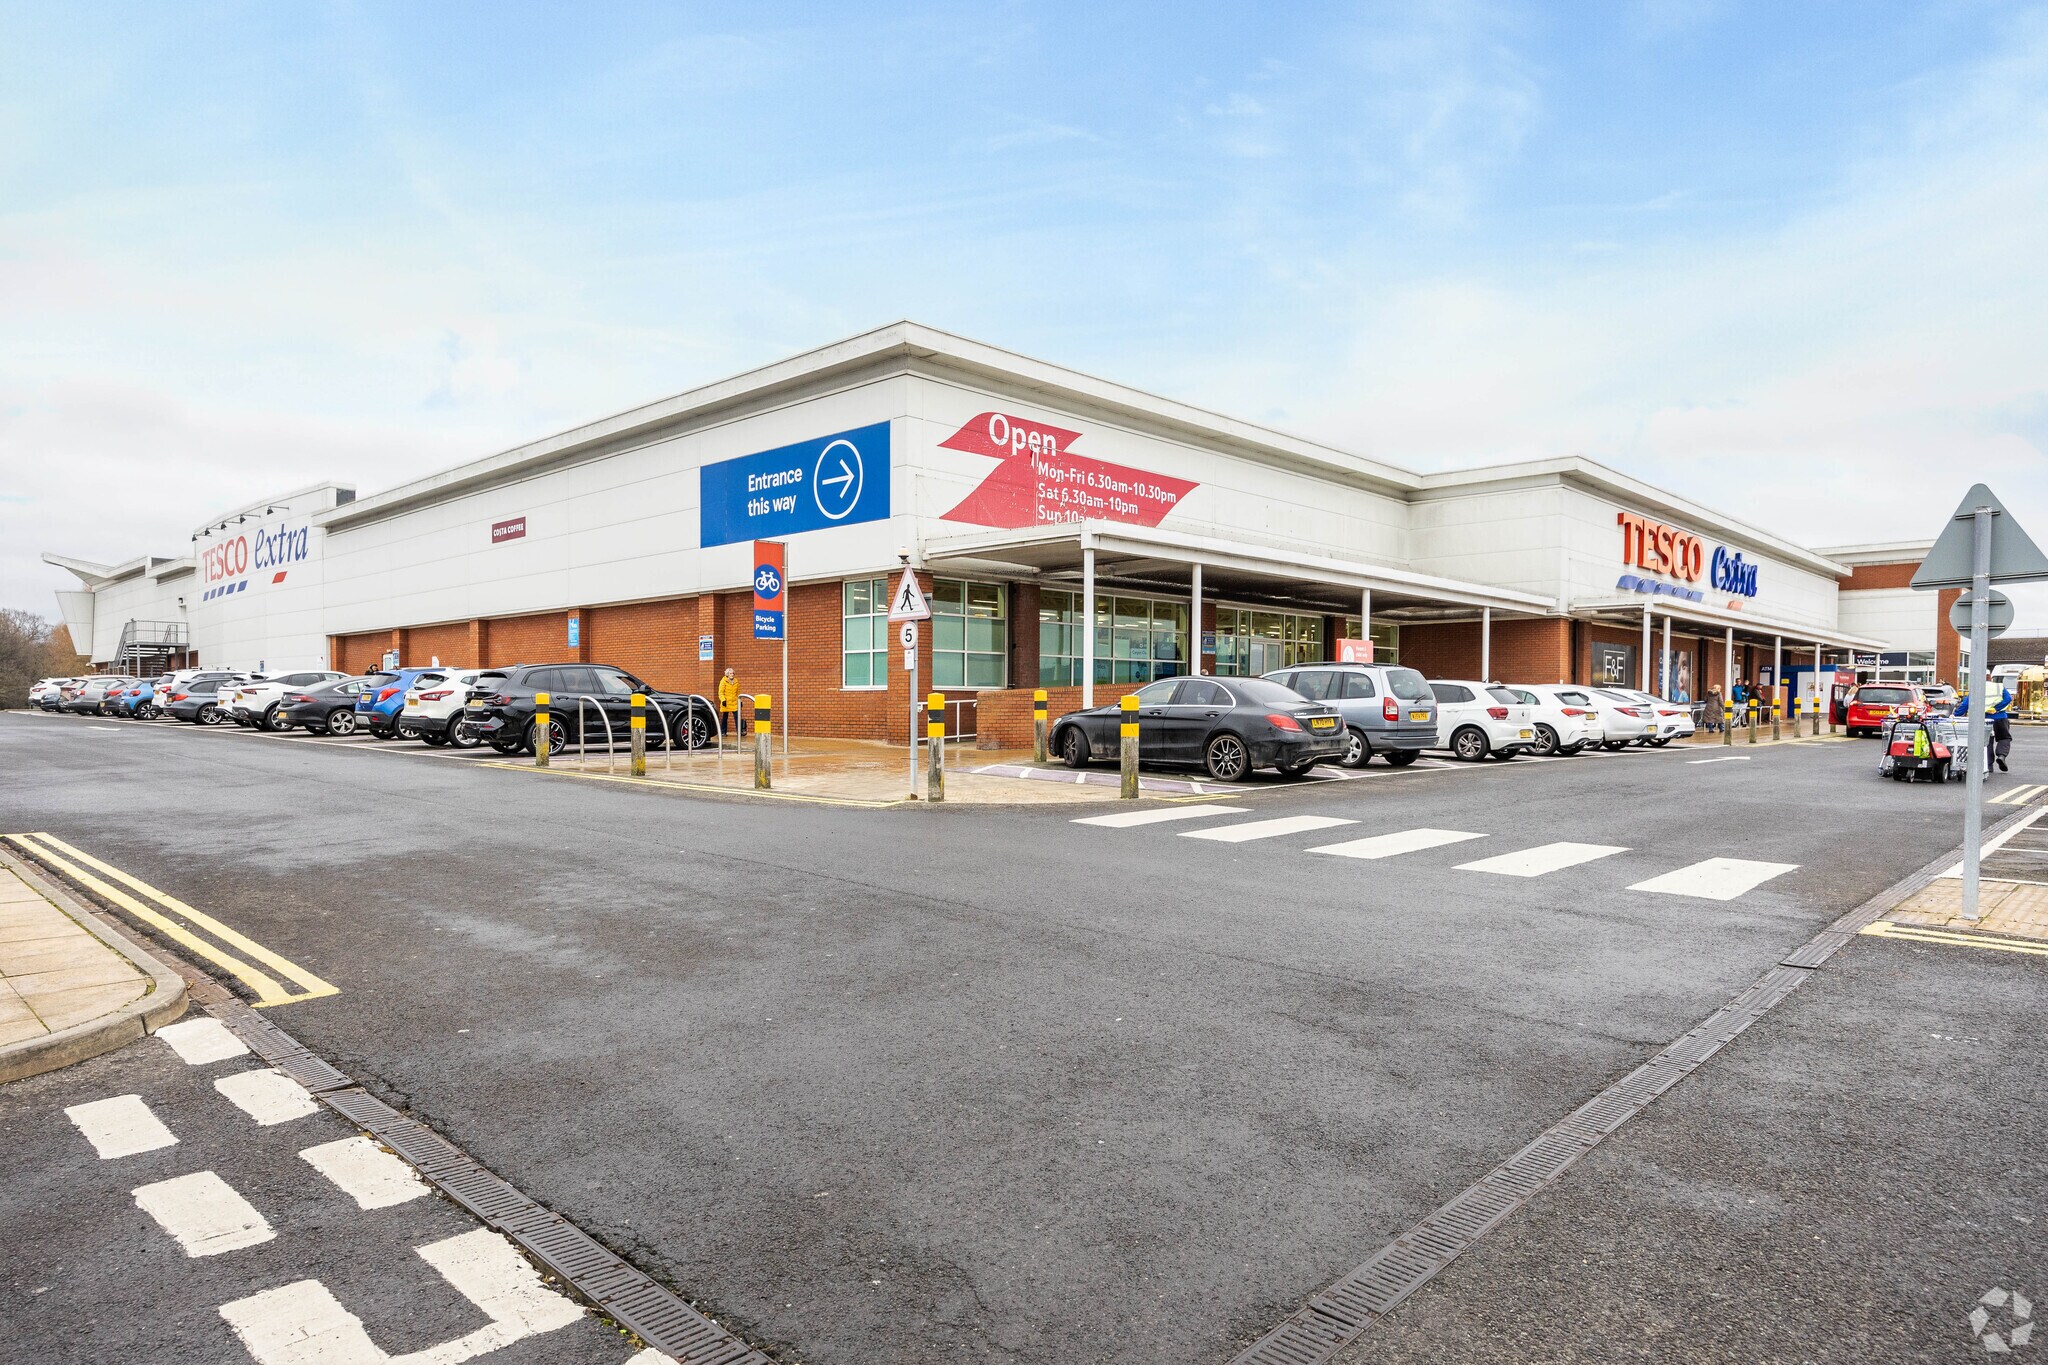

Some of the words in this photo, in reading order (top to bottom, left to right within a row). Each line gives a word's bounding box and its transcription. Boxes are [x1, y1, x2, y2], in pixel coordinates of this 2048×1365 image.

[989, 413, 1057, 456] Open
[748, 468, 803, 492] Entrance
[1038, 461, 1085, 484] Mon-Fri
[1088, 472, 1177, 504] 6.30am-10.30pm
[748, 497, 770, 517] this
[772, 495, 797, 514] way
[1038, 483, 1059, 500] Sat
[1061, 488, 1139, 516] 6.30am-10pm
[493, 527, 507, 537] COSTA
[507, 523, 524, 534] COFFEE
[203, 536, 248, 583] TESCO
[1617, 512, 1704, 583] TESCO
[755, 615, 775, 623] Bicycle
[755, 624, 777, 632] Parking
[905, 629, 913, 642] 5
[1605, 655, 1624, 680] F&F
